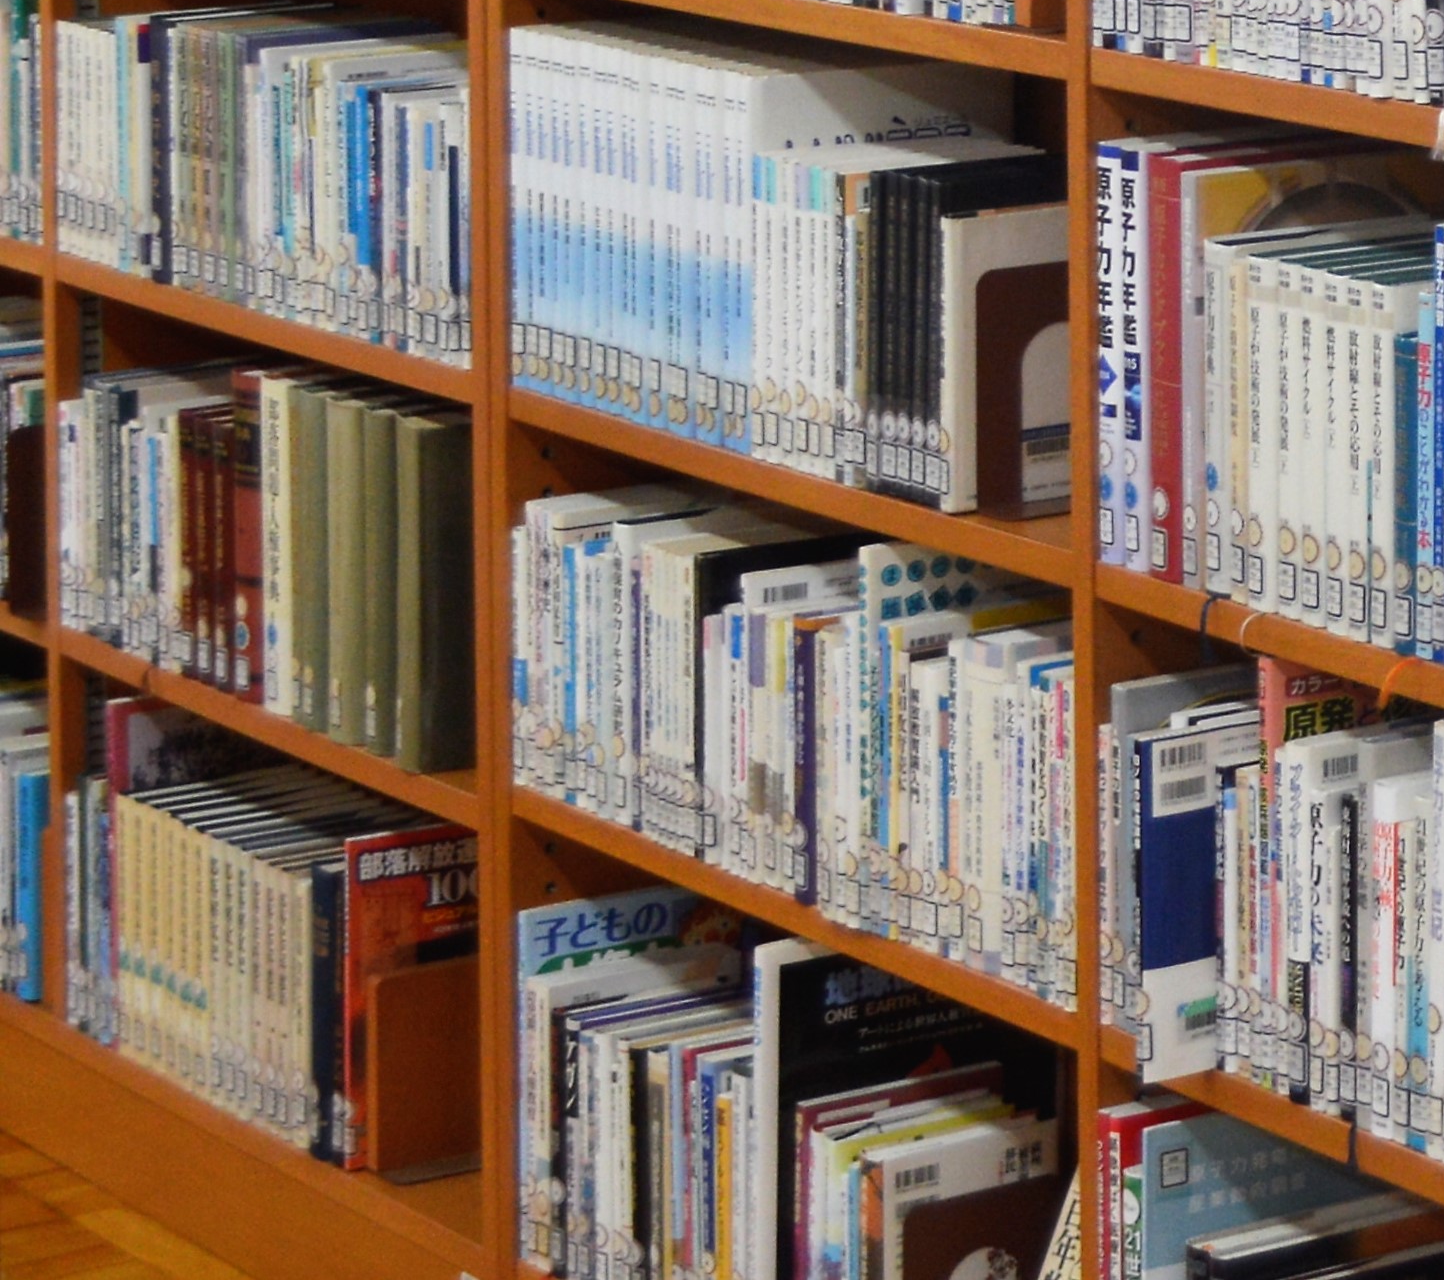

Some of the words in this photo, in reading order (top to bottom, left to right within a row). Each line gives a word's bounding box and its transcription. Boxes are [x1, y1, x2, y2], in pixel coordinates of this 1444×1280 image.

[1121, 177, 1137, 347] 原子力年鑑
[533, 903, 669, 959] 子どもの
